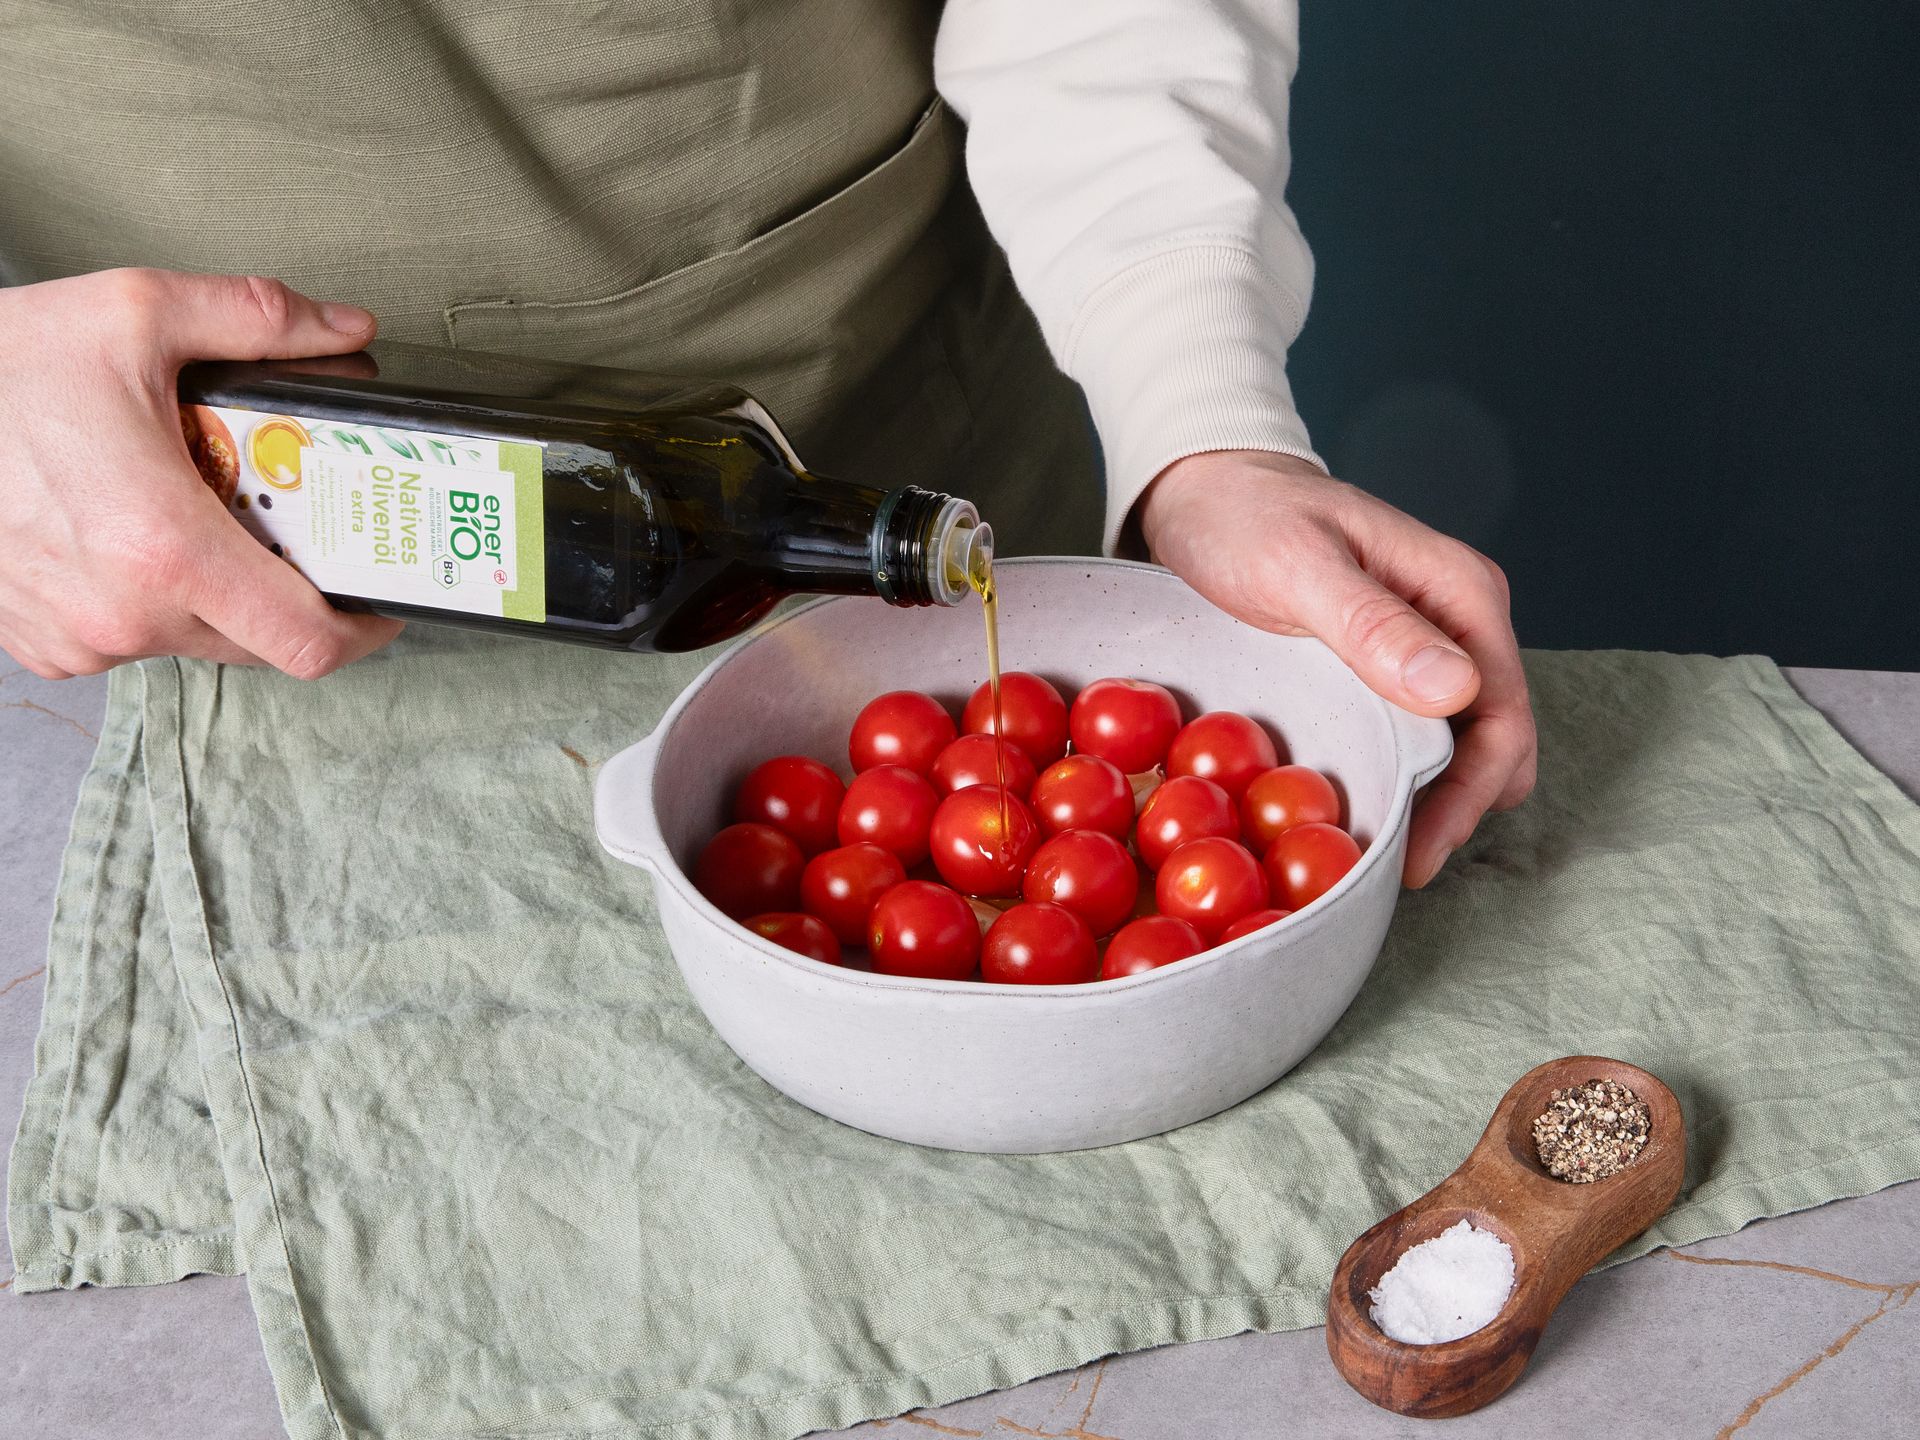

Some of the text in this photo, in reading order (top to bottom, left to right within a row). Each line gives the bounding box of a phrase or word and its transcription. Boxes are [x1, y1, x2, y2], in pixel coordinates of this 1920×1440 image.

[351, 490, 366, 533] extra
[371, 465, 397, 564] Olivenöl
[398, 472, 423, 565] Natives
[483, 495, 501, 565] ener
